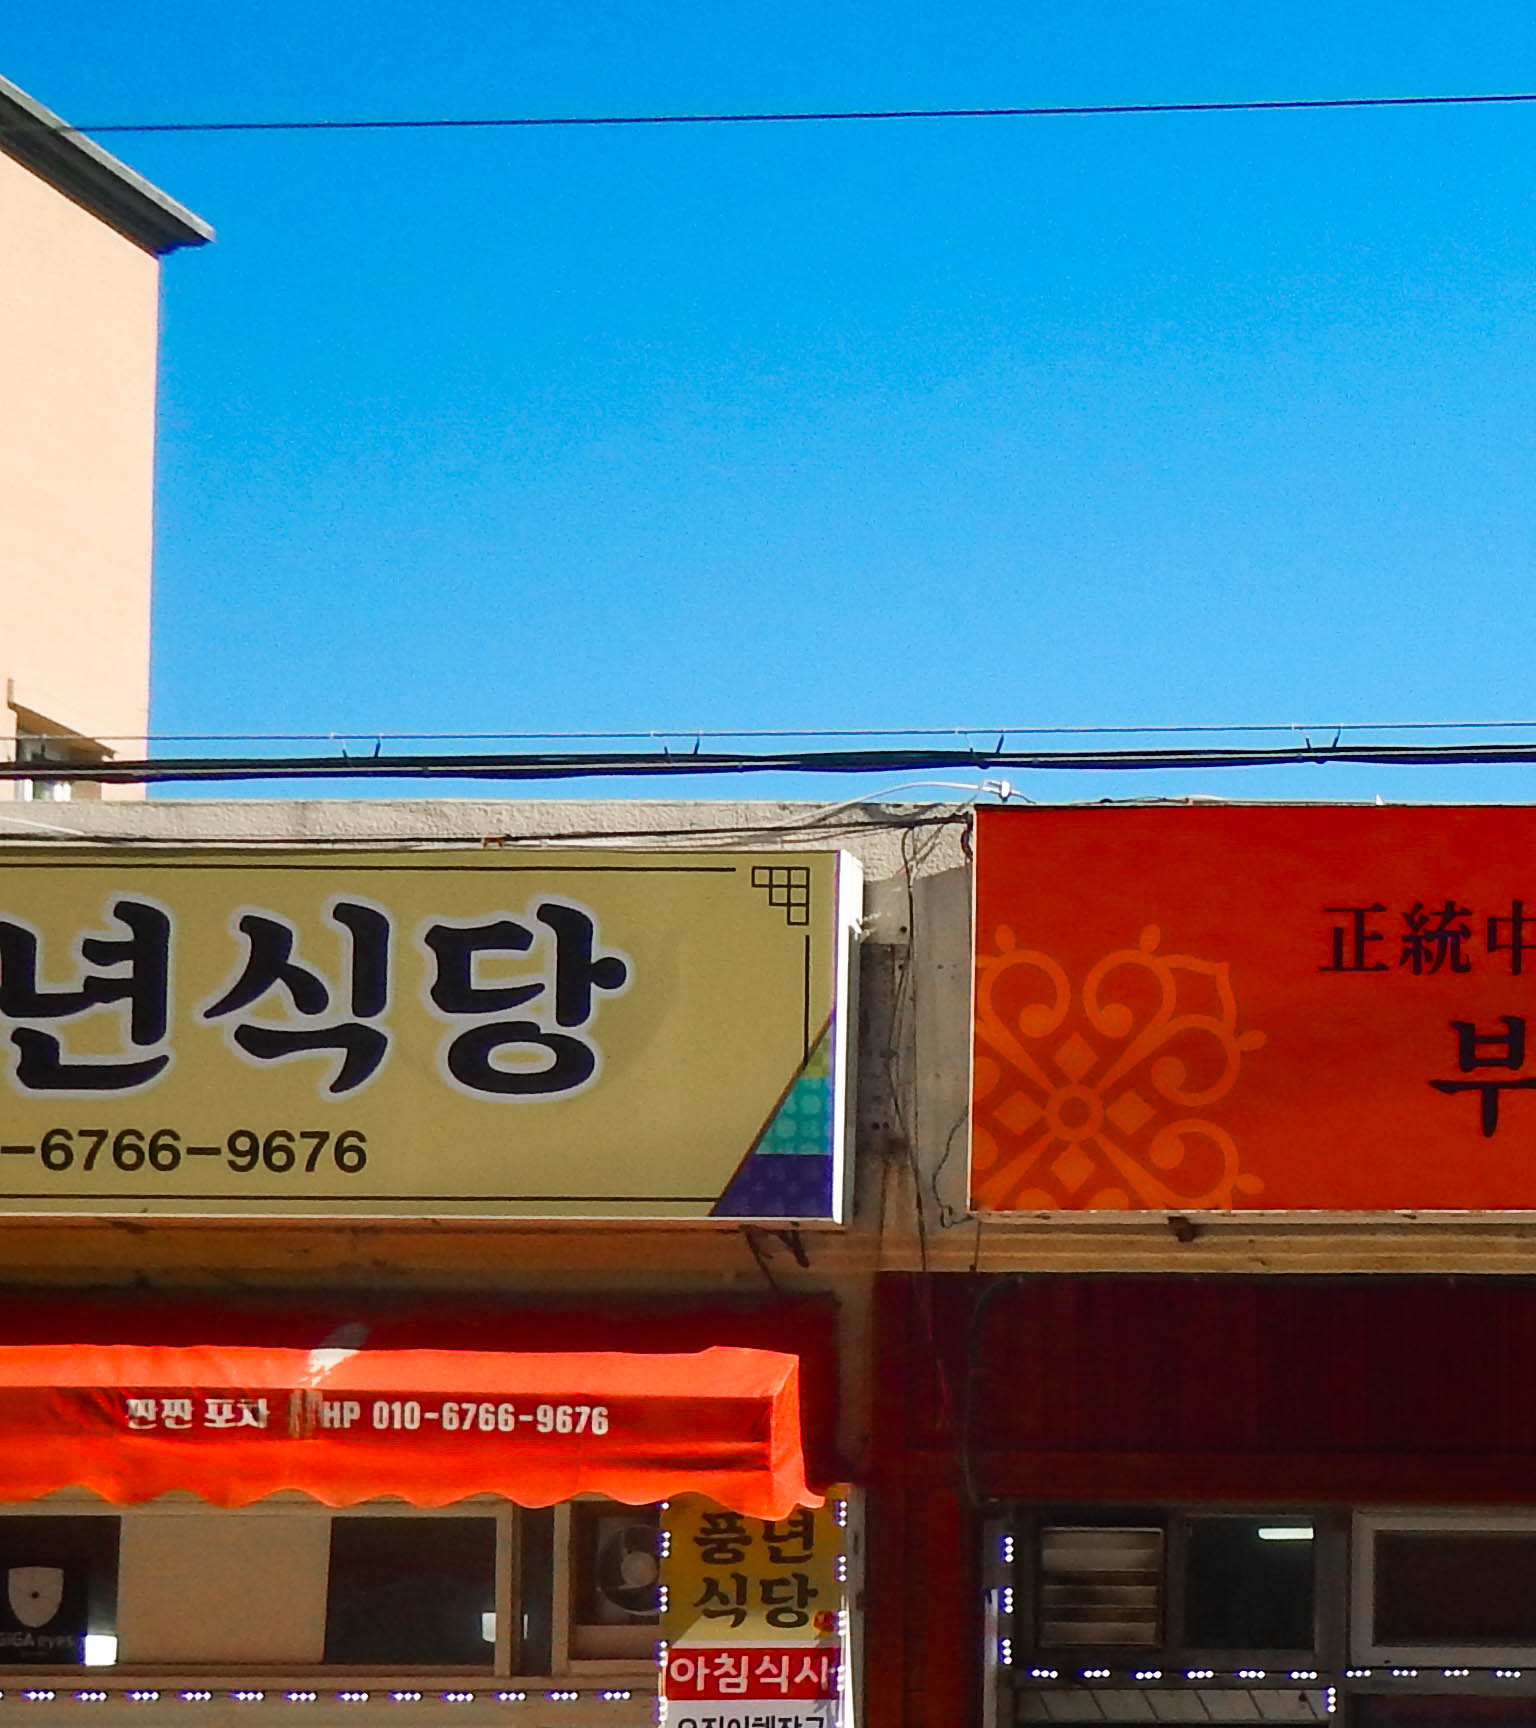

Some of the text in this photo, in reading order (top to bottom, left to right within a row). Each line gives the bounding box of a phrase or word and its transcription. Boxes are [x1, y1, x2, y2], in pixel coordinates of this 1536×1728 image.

[0, 899, 628, 1095] 년식당
[321, 1400, 361, 1429] HP
[373, 1400, 610, 1435] 010-6766-9676
[693, 1508, 818, 1566] 풍년
[694, 1572, 820, 1629] 식당
[669, 1652, 836, 1694] 아침식사
